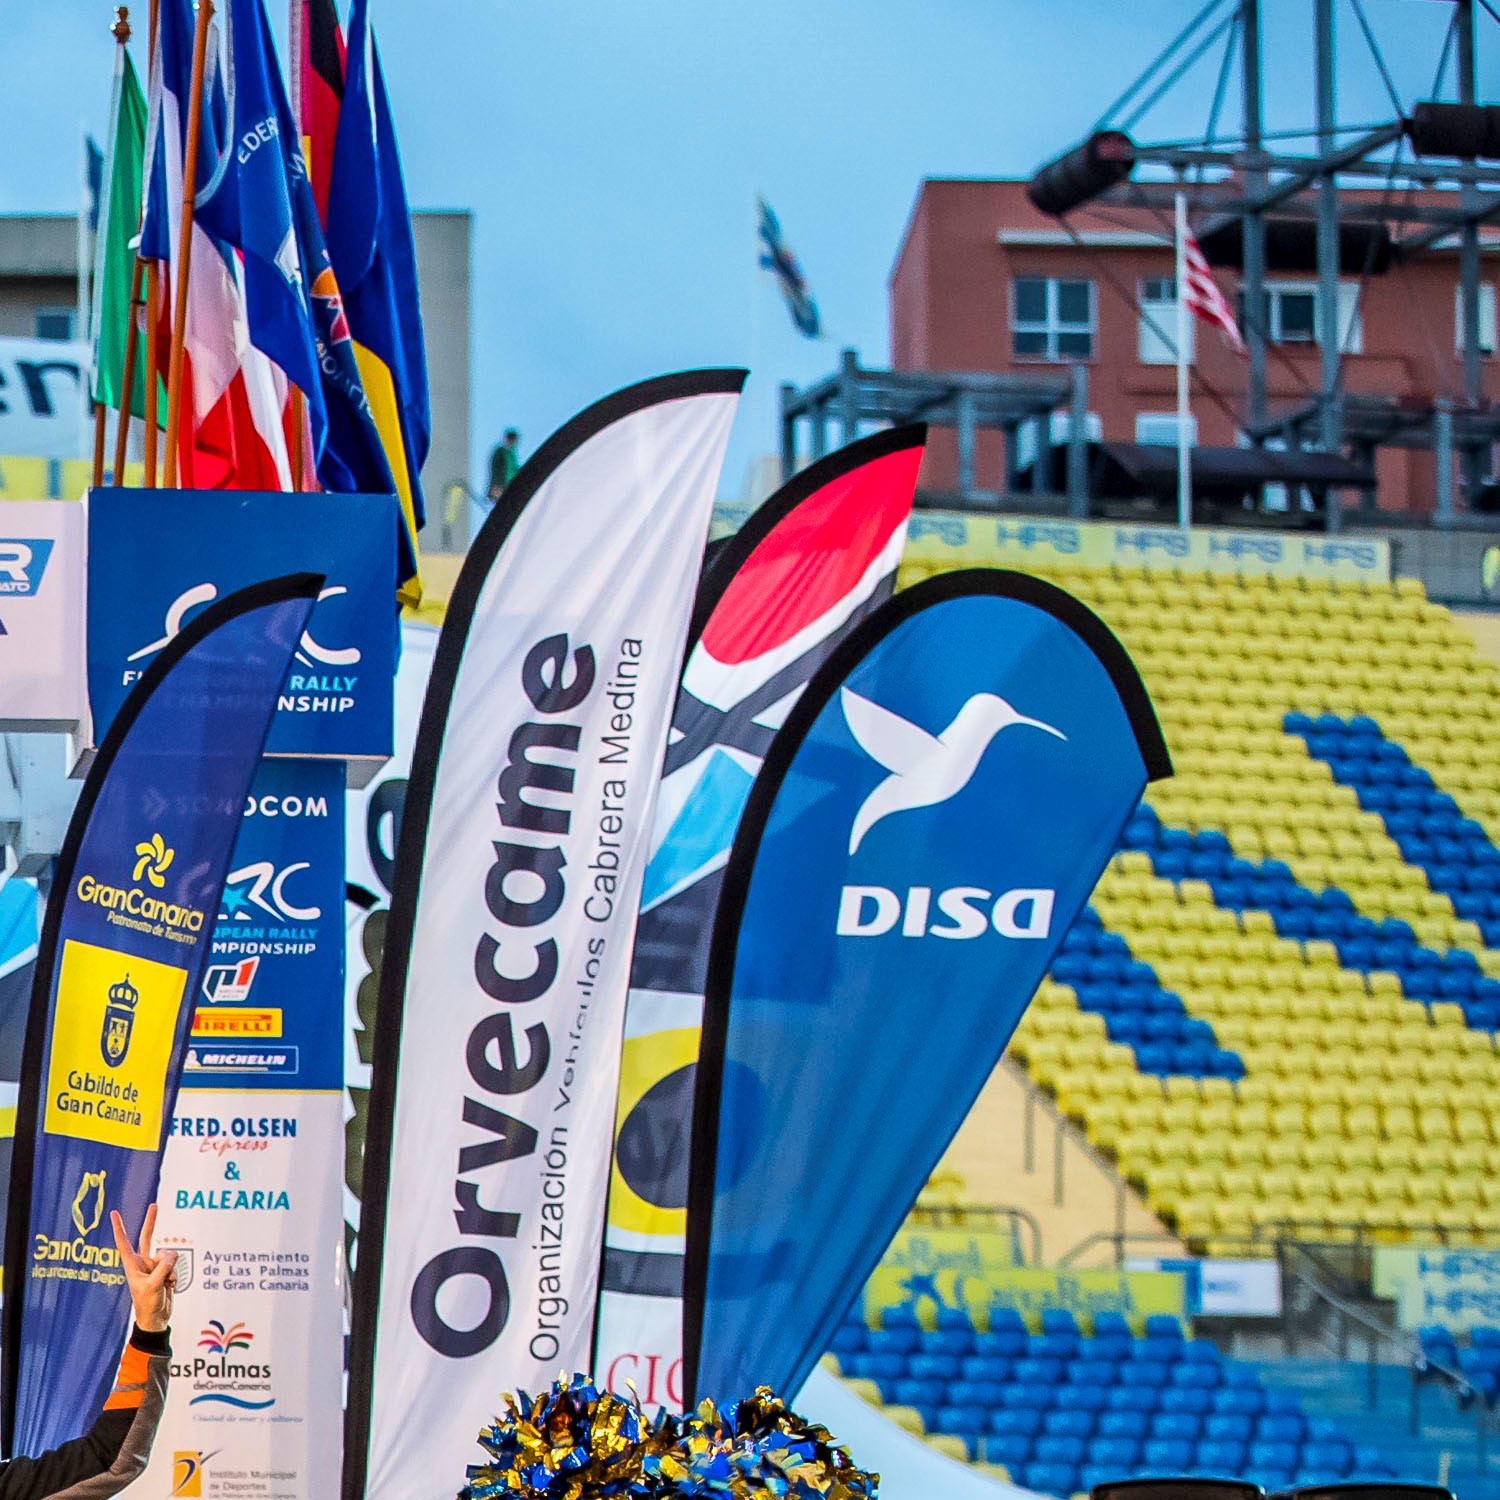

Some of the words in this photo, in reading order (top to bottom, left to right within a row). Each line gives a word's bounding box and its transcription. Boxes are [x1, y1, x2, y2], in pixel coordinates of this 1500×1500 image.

[600, 635, 645, 764] Medina
[584, 781, 626, 926] Cabrera
[837, 886, 1055, 939] DISA
[411, 631, 597, 1358] Orvecame
[550, 935, 606, 1114] Vehículos
[202, 1053, 287, 1066] MICHELIN
[232, 1117, 297, 1138] OLSEN
[198, 1136, 270, 1157] Express
[223, 1160, 242, 1181] &
[175, 1189, 292, 1212] BALEARIA
[203, 1249, 310, 1265] Ayuntamiento
[530, 1127, 570, 1366] Organización
[203, 1265, 220, 1278] de
[228, 1265, 252, 1278] Las
[259, 1265, 310, 1278] Palmas
[203, 1278, 220, 1292] de
[222, 1278, 254, 1292] Gran
[258, 1278, 311, 1292] Canaria
[170, 1358, 272, 1381] asPalmas
